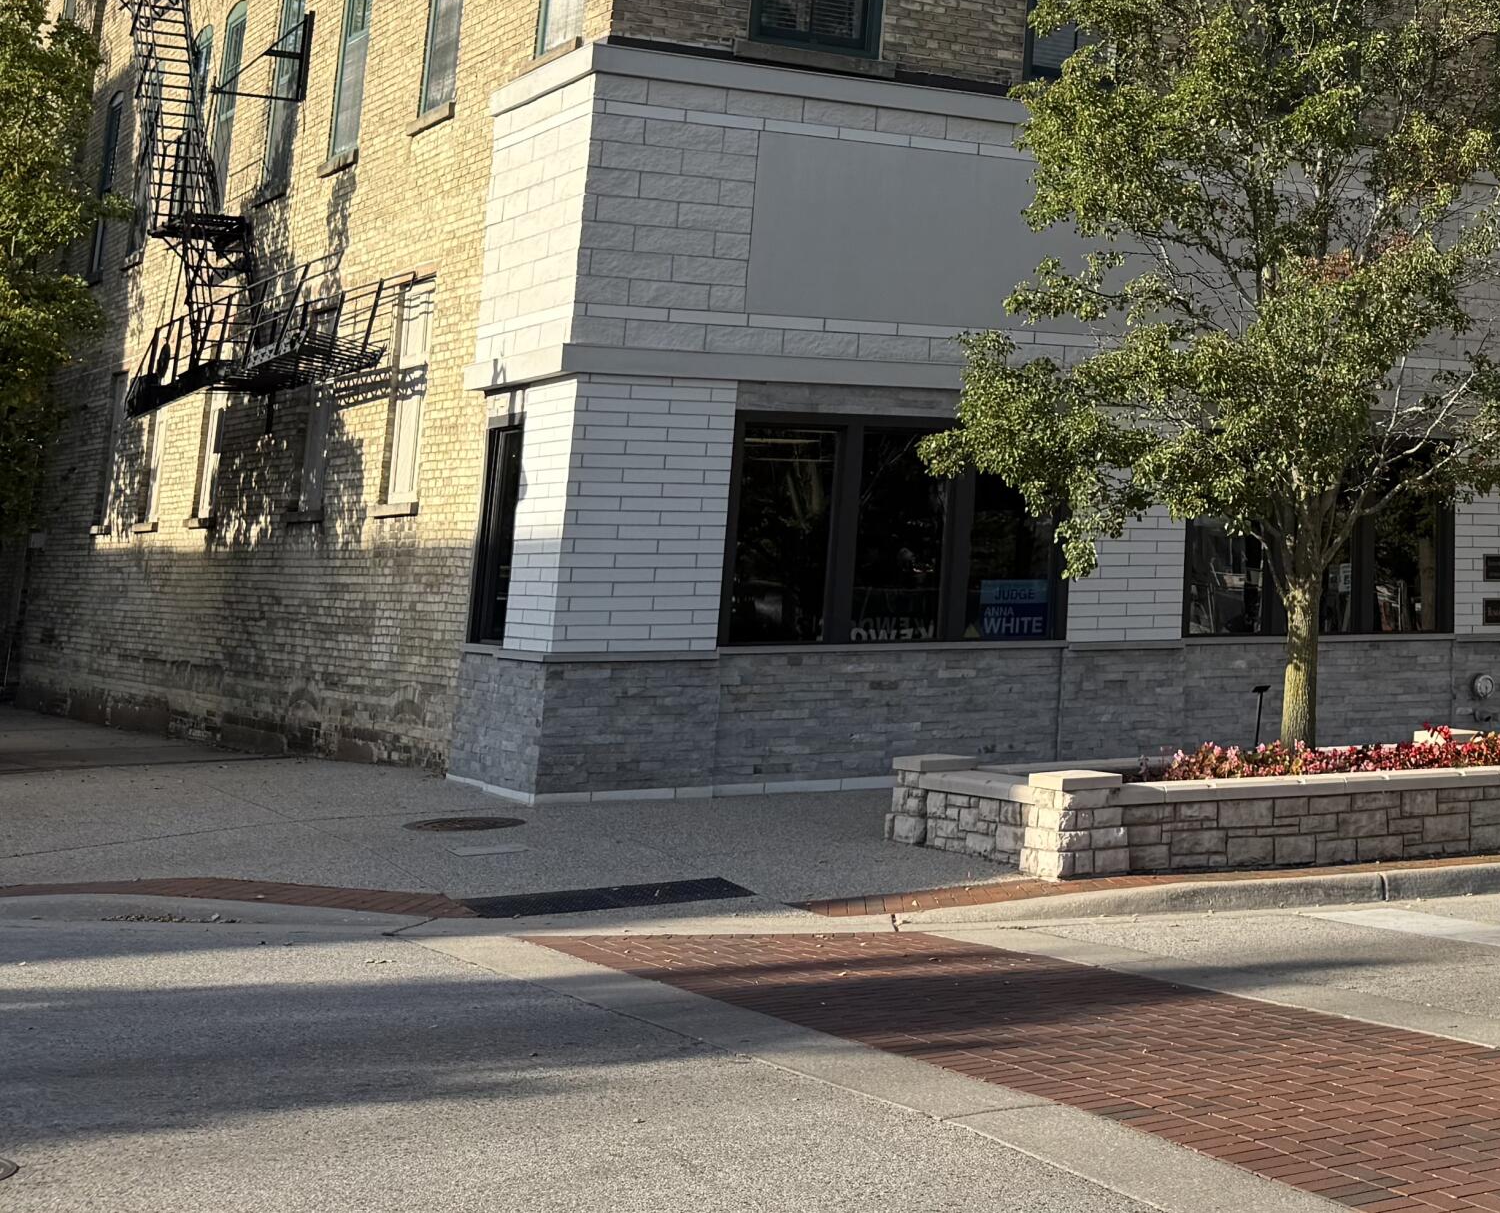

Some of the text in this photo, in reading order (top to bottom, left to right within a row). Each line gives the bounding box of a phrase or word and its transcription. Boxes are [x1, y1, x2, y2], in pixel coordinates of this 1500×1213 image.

[994, 588, 1036, 600] JUDGE
[983, 606, 1015, 617] ANNA
[983, 616, 1044, 635] WHITE
